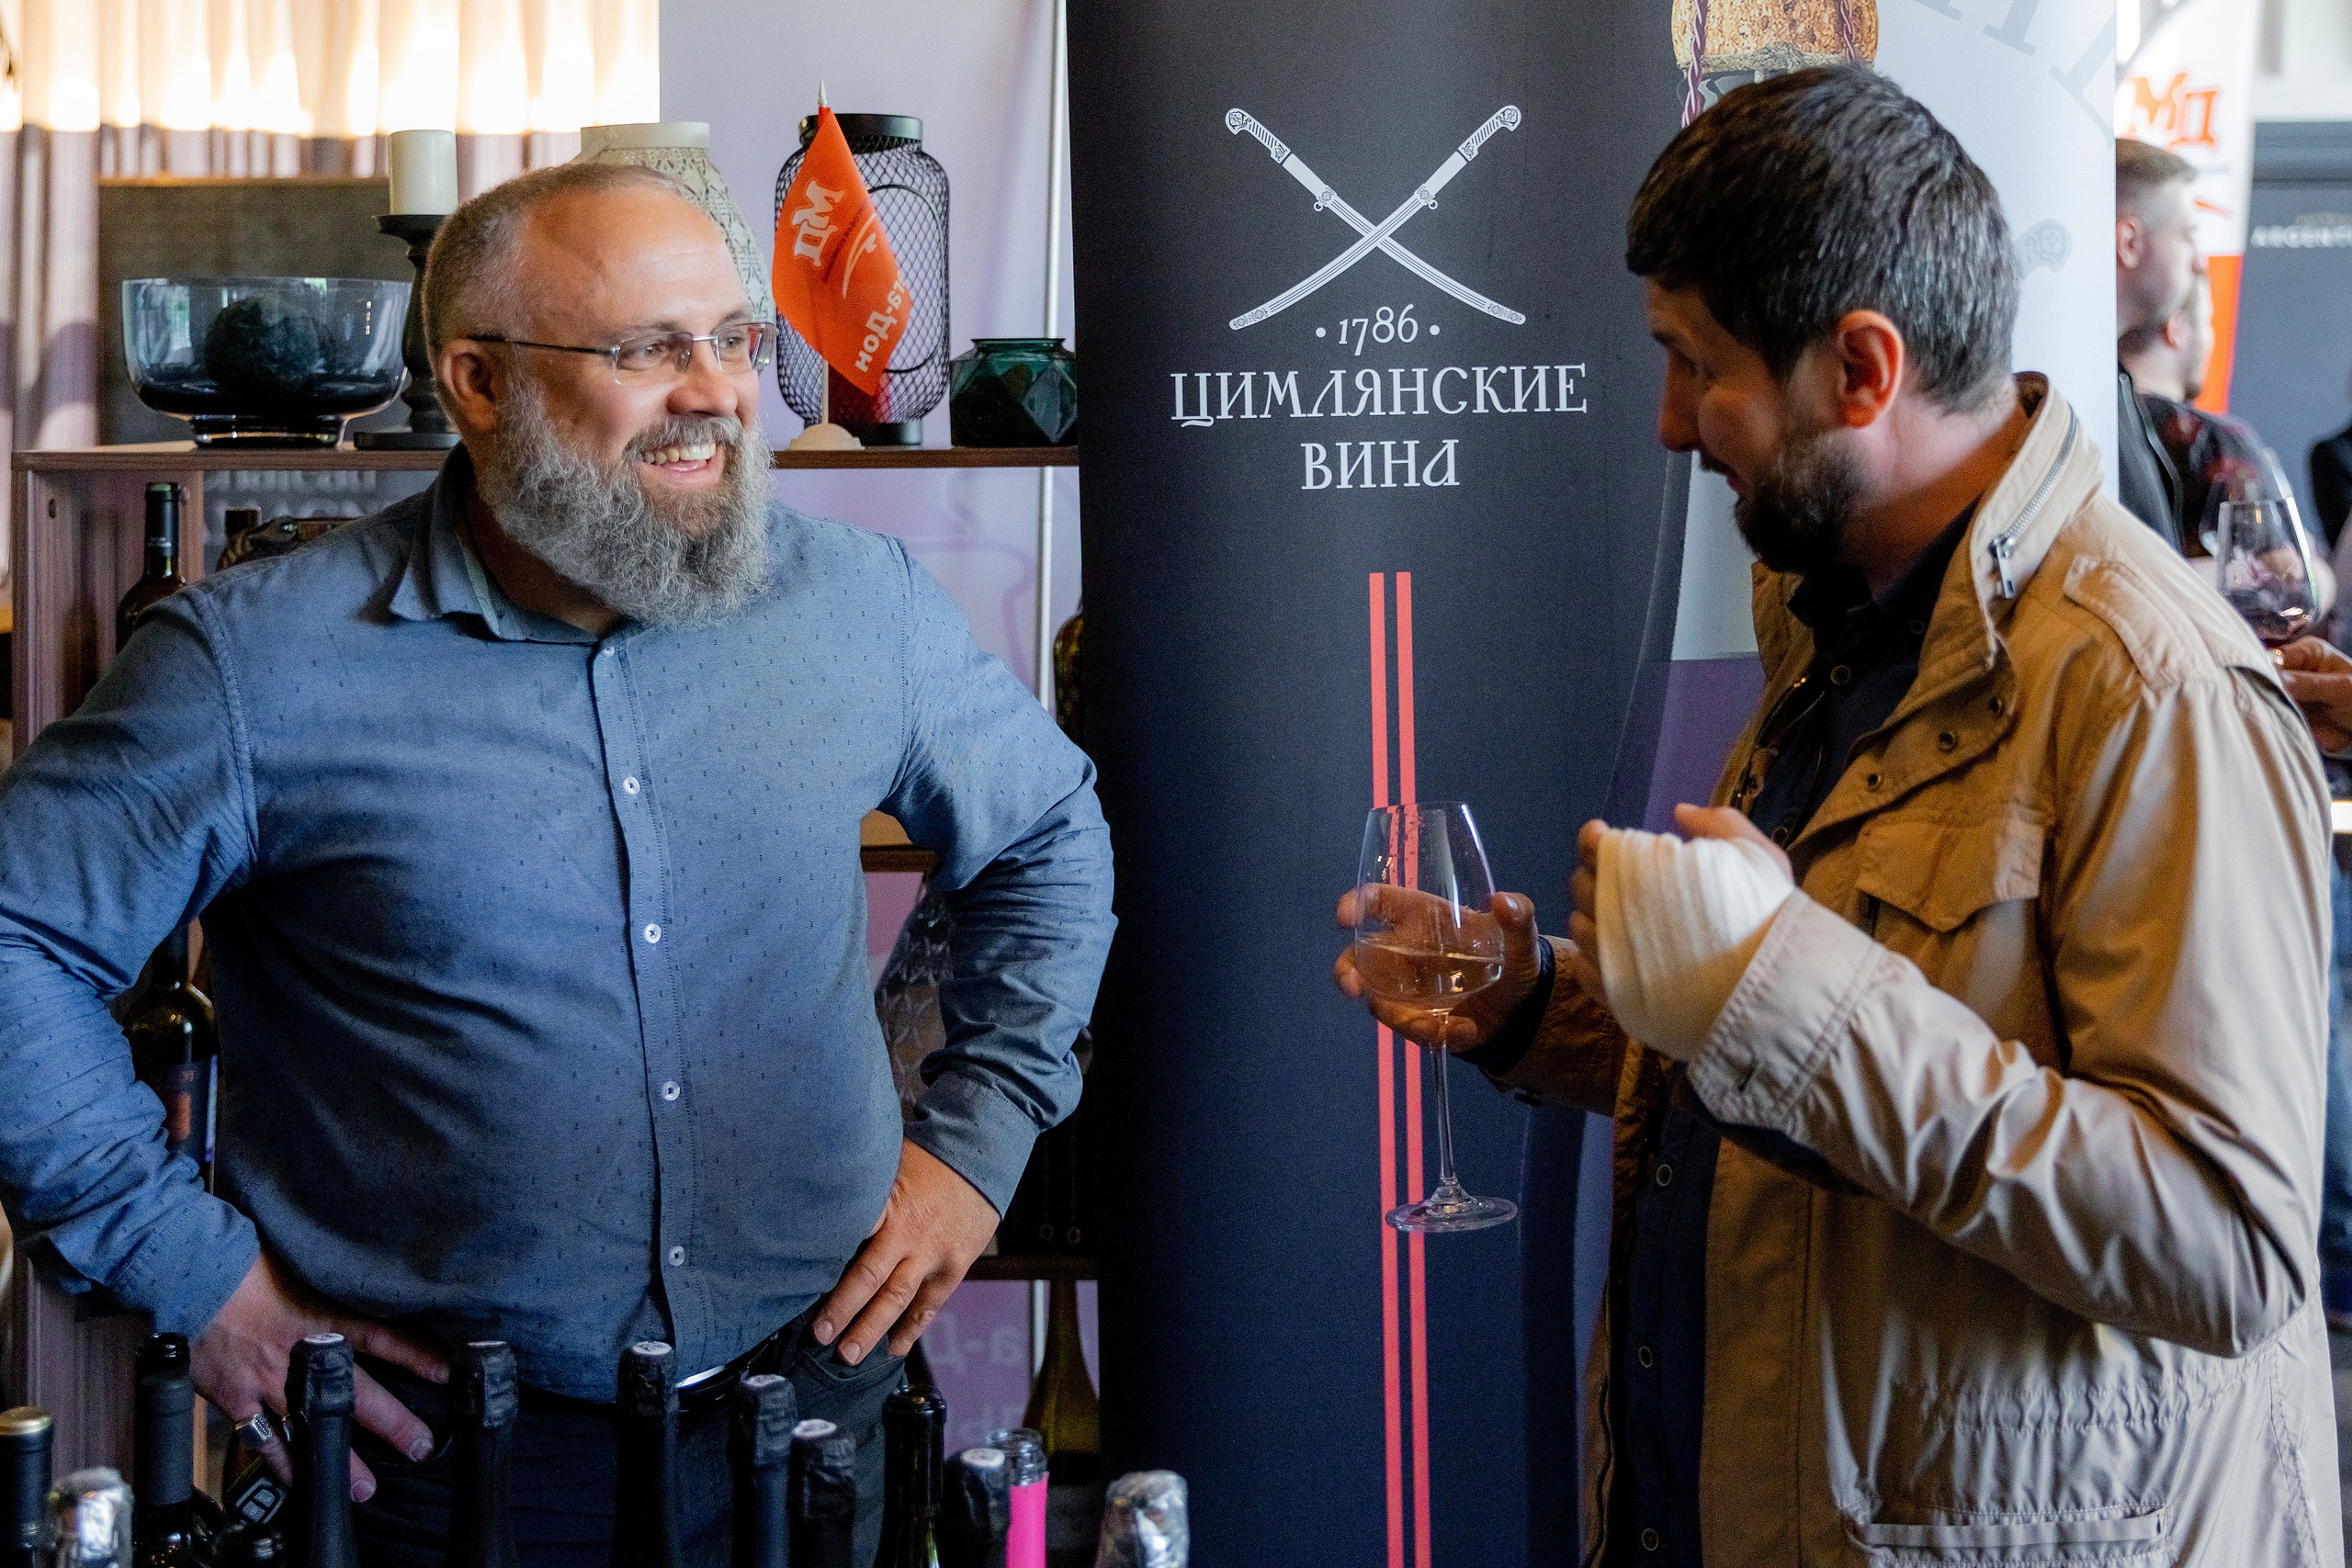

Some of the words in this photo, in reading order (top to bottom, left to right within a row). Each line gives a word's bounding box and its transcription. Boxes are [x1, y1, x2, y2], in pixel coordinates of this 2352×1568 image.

[1338, 303, 1419, 356] 1786
[1170, 362, 1588, 428] ЦИМЛЯНСКИЕ
[1300, 438, 1461, 491] ВИНА
